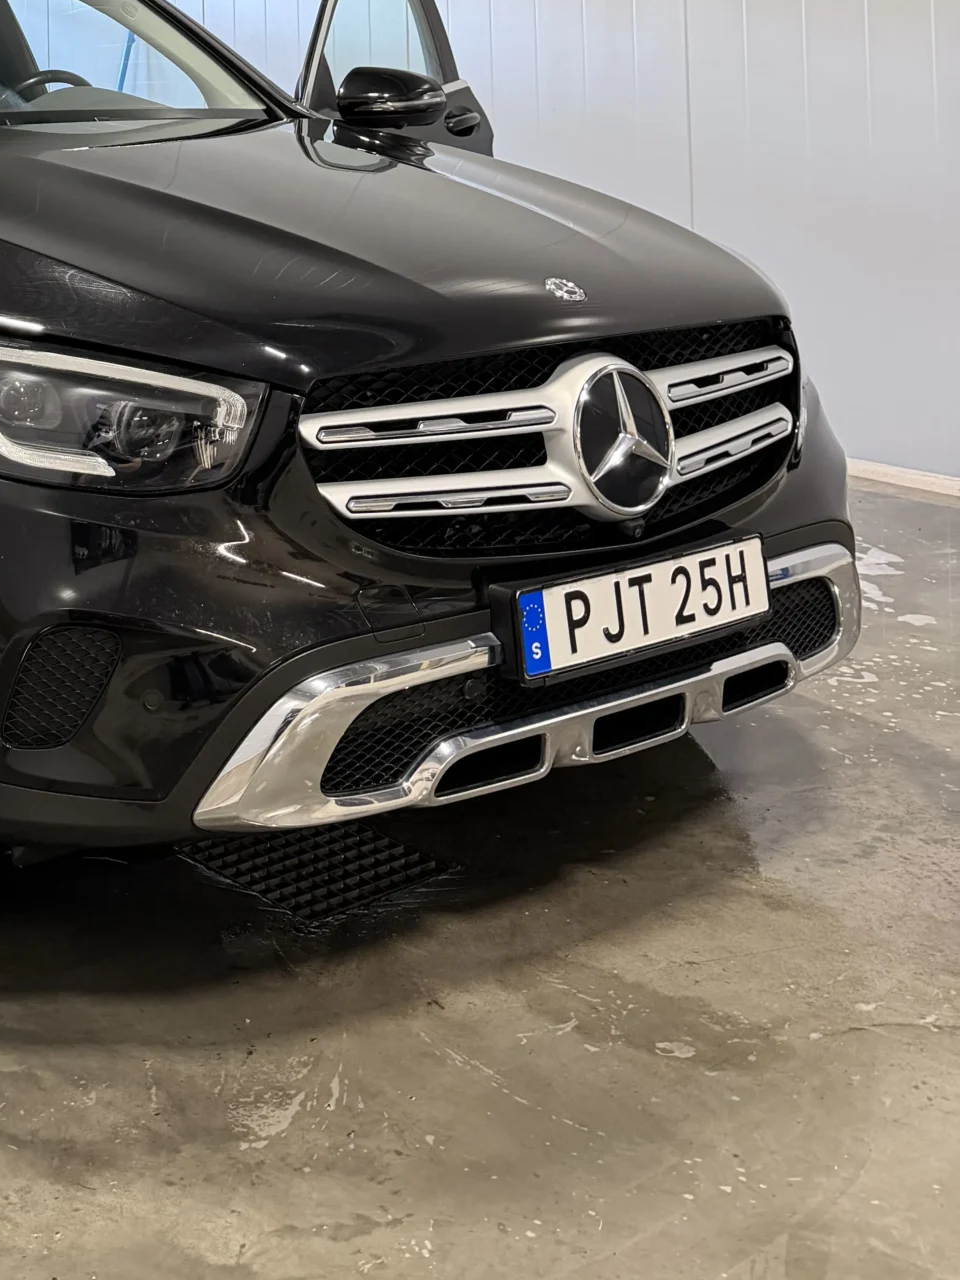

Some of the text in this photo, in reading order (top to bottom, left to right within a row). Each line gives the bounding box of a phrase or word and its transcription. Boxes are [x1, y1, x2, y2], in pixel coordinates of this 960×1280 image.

[564, 550, 752, 654] PJT 25H
[532, 642, 542, 660] S
